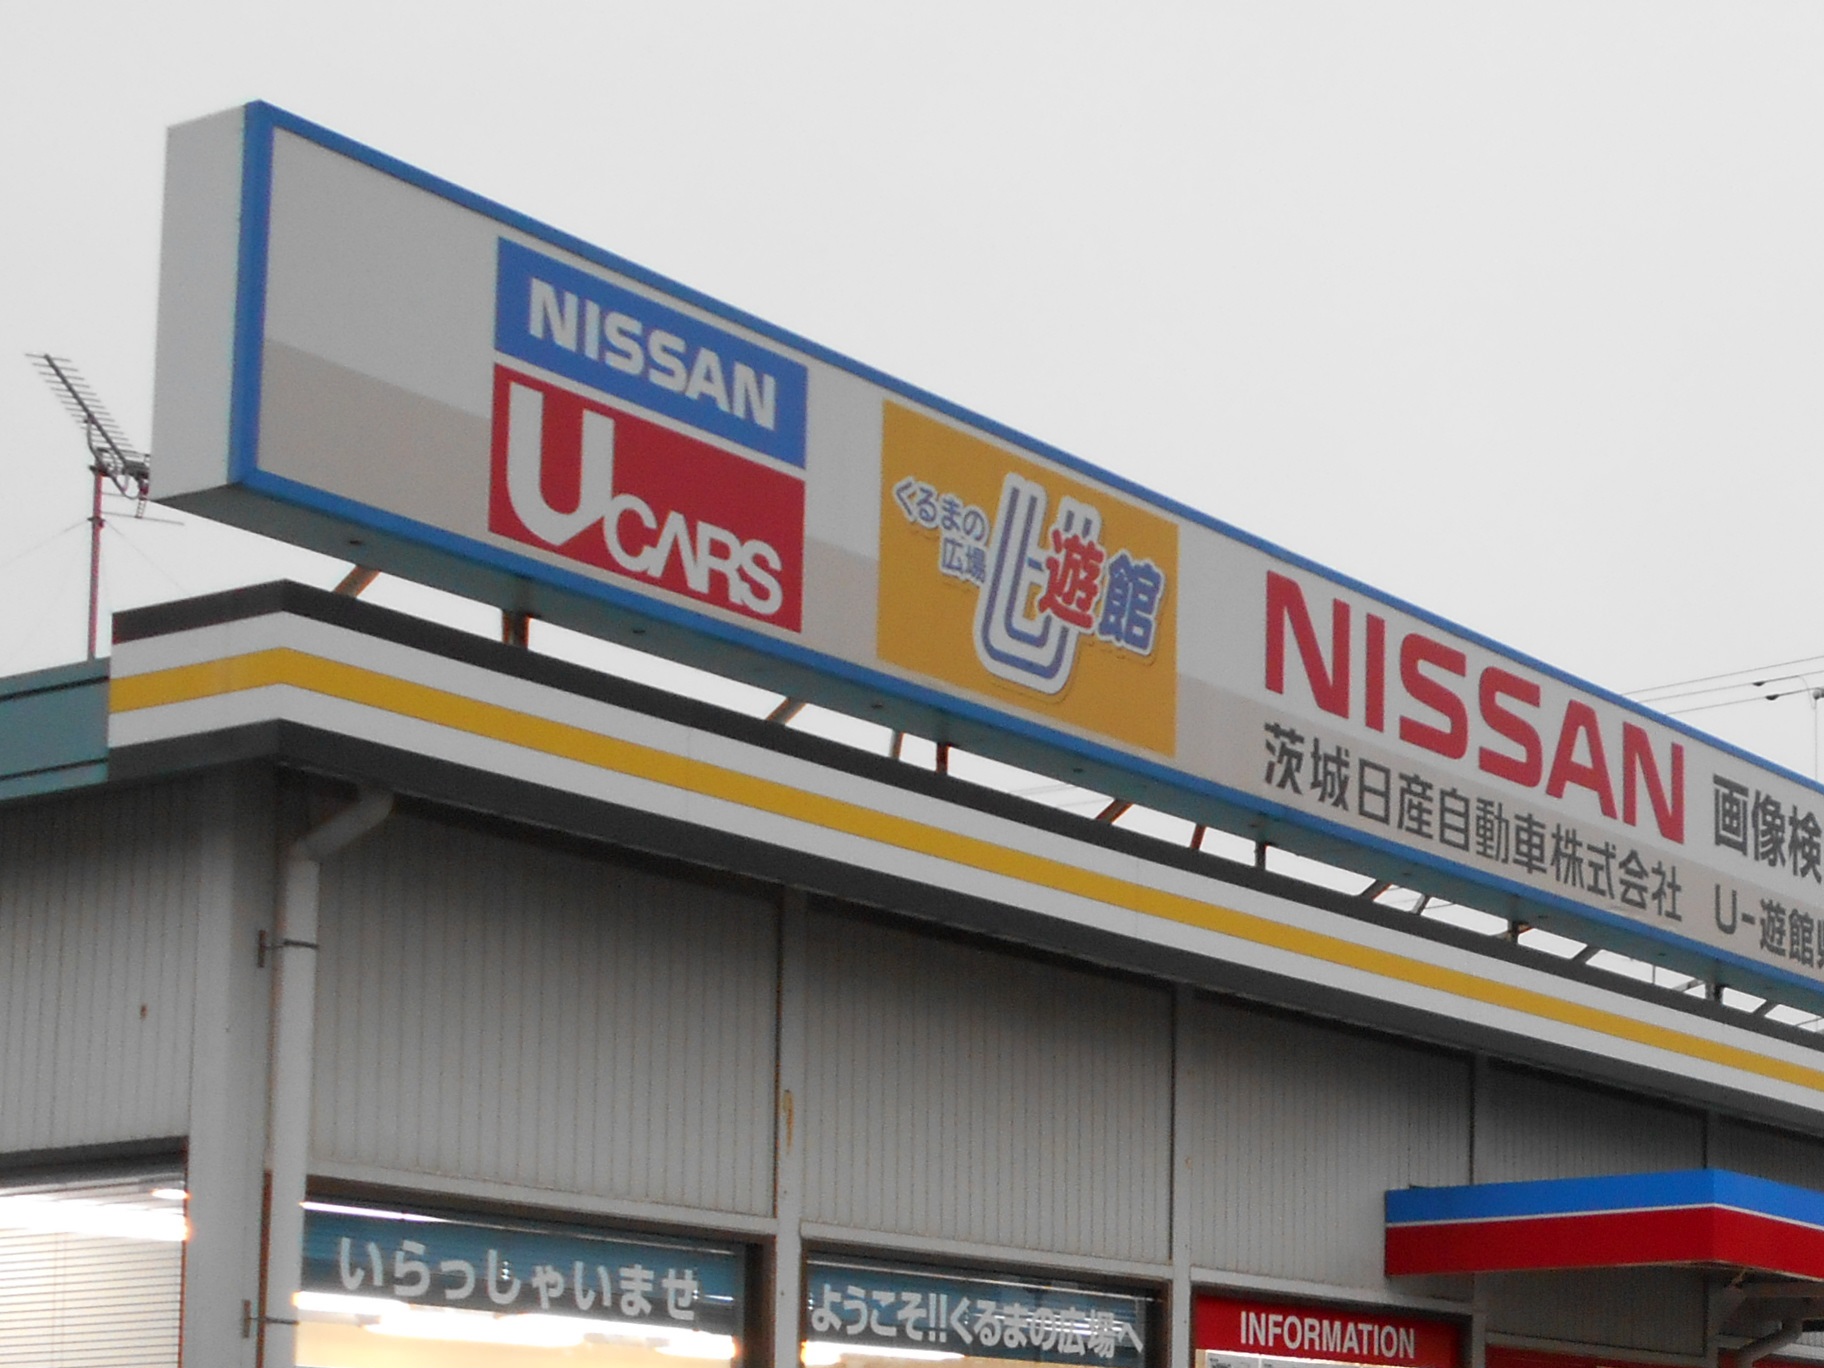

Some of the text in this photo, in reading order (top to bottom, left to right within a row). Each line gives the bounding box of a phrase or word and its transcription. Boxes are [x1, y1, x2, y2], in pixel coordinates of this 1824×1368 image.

[528, 277, 776, 431] NISSAN
[895, 478, 988, 542] くるまの
[941, 536, 987, 586] 広場
[1264, 569, 1685, 845] NISSAN
[1263, 721, 1683, 922] 茨城日産自動車株式会社
[338, 1236, 698, 1322] いらっしゃいませ
[1240, 1310, 1416, 1359] INFORMATION
